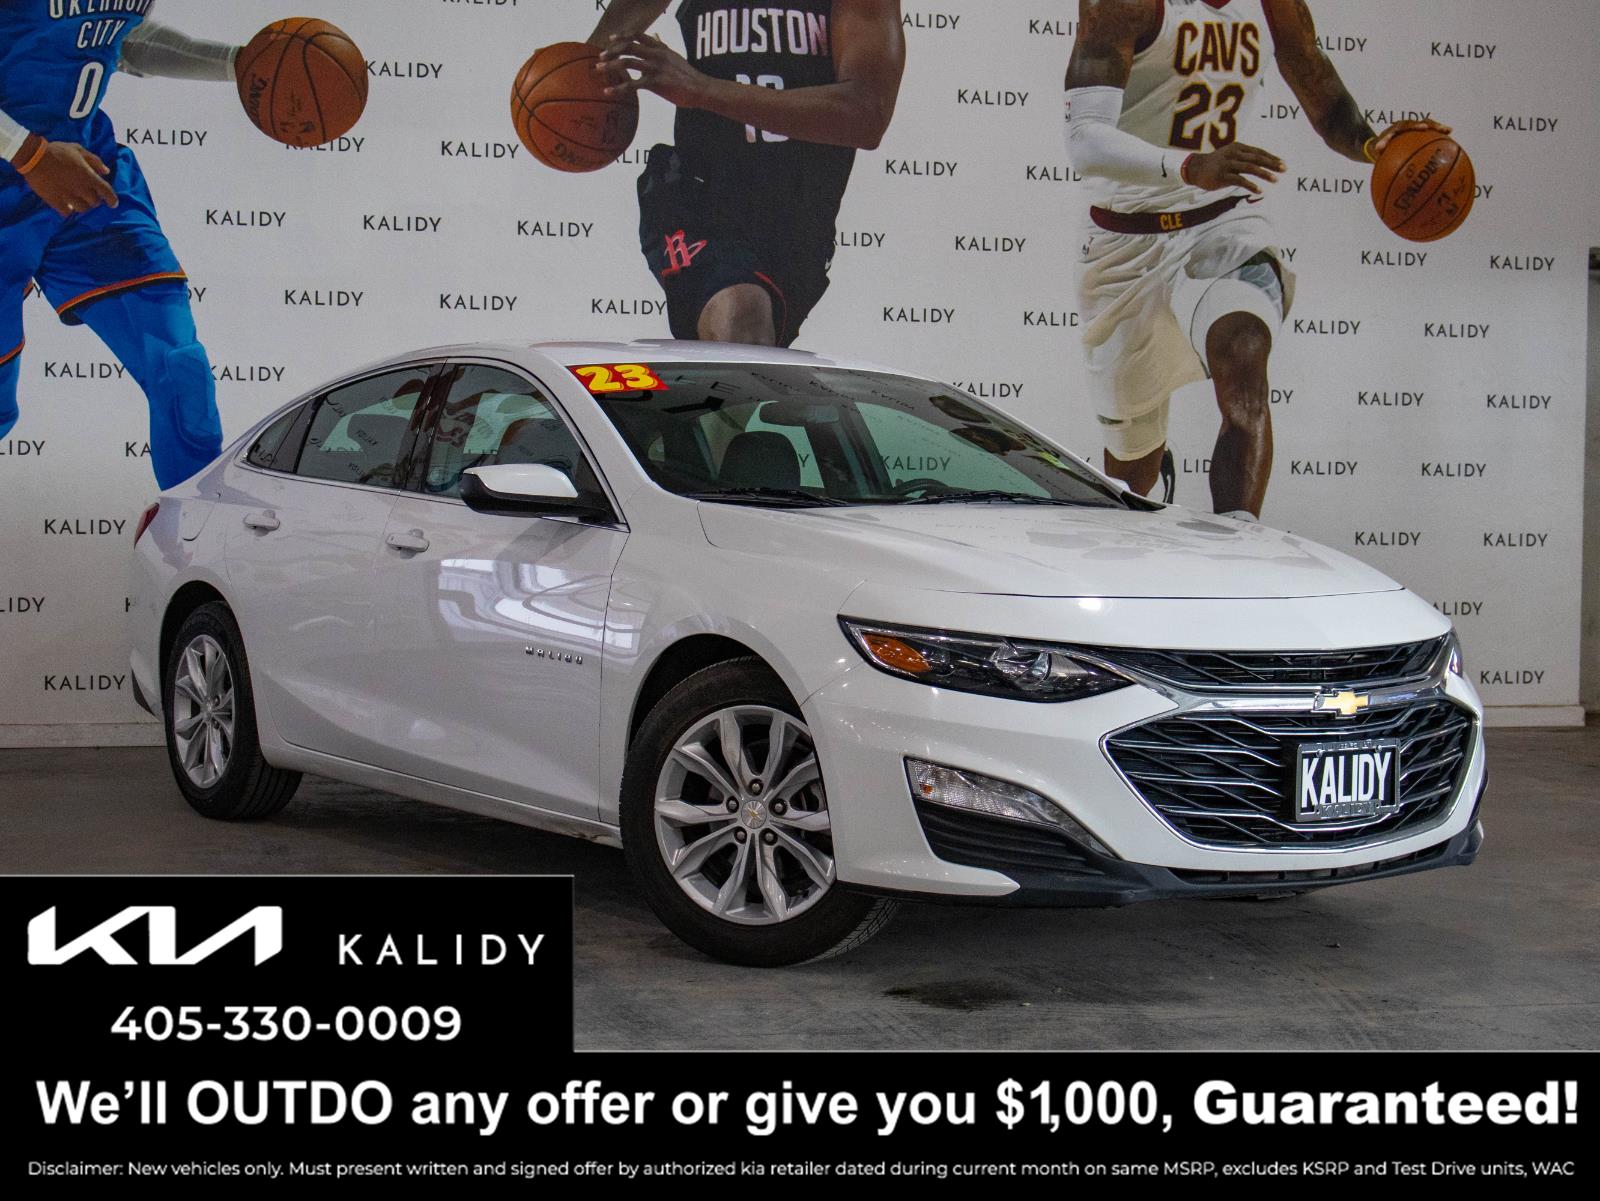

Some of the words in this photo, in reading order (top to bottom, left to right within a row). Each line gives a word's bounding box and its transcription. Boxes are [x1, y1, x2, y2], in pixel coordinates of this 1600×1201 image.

[903, 13, 960, 30] ALIDY
[1029, 20, 1079, 36] KALI
[76, 19, 126, 49] CITY
[696, 8, 828, 59] HOUSTON
[1174, 20, 1261, 77] CAVS
[1315, 36, 1367, 52] ALIDY
[1431, 42, 1496, 59] KALIDY
[367, 61, 443, 79] KALIDY
[69, 62, 104, 119] 0
[958, 89, 1028, 106] KALIDY
[1168, 82, 1246, 151] 23
[1494, 116, 1558, 132] KALIDY
[127, 128, 207, 147] KALIDY
[441, 141, 519, 160] KALIDY
[886, 160, 957, 176] KALIDY
[1026, 166, 1081, 183] KALID
[1298, 178, 1364, 193] KALIDY
[206, 210, 285, 227] KALIDY
[364, 215, 441, 232] KALIDY
[1159, 212, 1183, 231] CLE
[518, 221, 593, 237] KALIDY
[834, 233, 886, 249] LIDY
[955, 236, 1026, 252] KALIDY
[1361, 251, 1427, 266] KALIDY
[1490, 256, 1554, 271] KALIDY
[285, 290, 363, 306] KALIDY
[440, 294, 517, 310] KALIDY
[592, 299, 667, 316] KALIDY
[884, 307, 954, 323] KALIDY
[1024, 311, 1079, 327] KALID
[1294, 320, 1360, 334] KALIDY
[1425, 323, 1489, 338] KALIDY
[44, 362, 125, 379] KALIDY
[575, 364, 656, 392] 23
[1358, 392, 1424, 406] KALIDY
[1487, 395, 1551, 409] KALIDY
[1291, 461, 1357, 475] KALIDY
[1422, 463, 1486, 477] KALIDY
[45, 519, 125, 535] KALIDY
[1355, 532, 1421, 546] KALIDY
[1484, 533, 1547, 547] KALIDY
[525, 645, 584, 665] MALIBU
[45, 675, 125, 690] KALIDY
[1480, 670, 1544, 684] KALIDY
[1302, 752, 1391, 808] KALIDY
